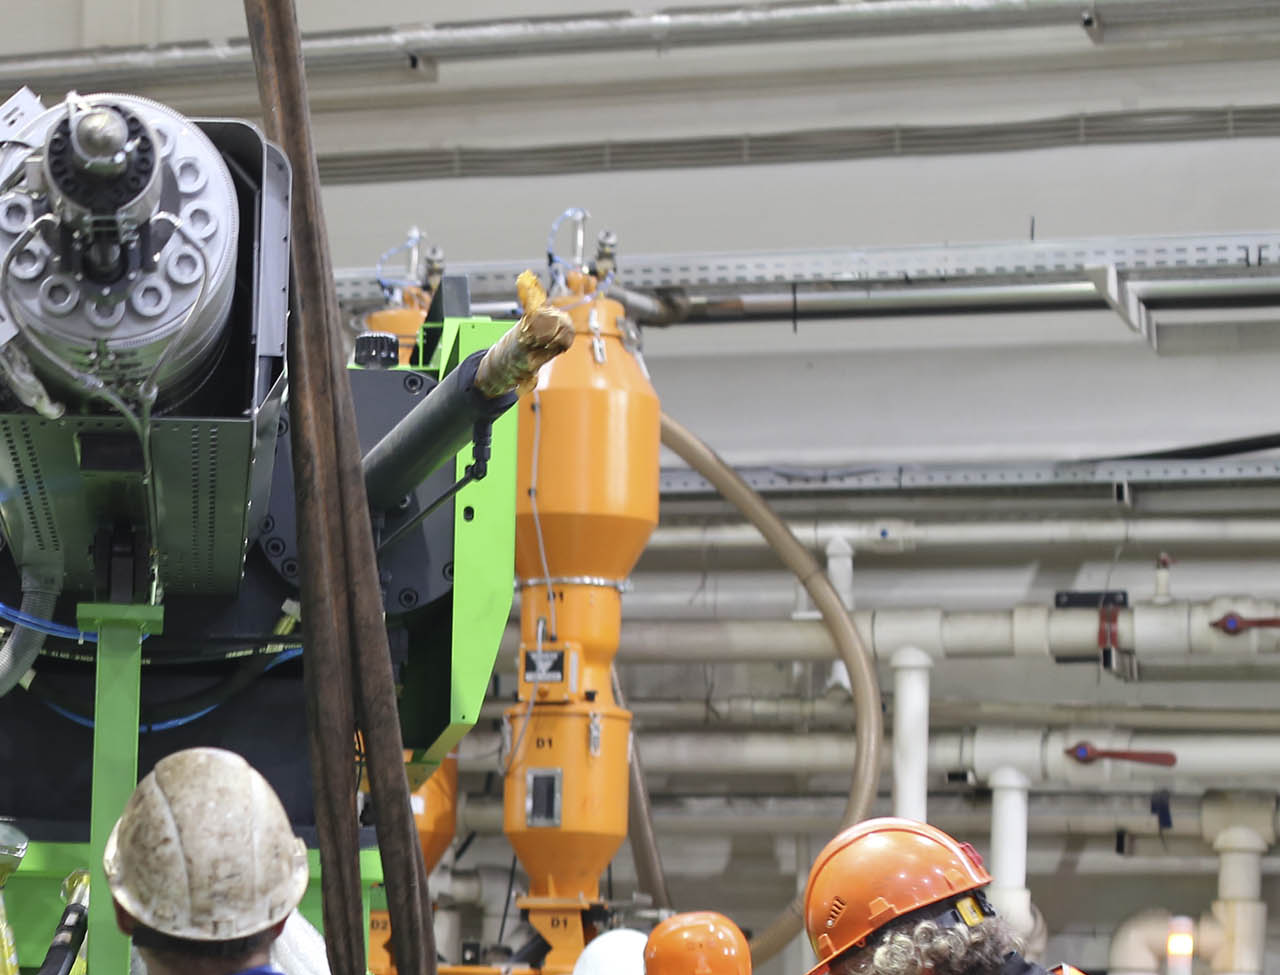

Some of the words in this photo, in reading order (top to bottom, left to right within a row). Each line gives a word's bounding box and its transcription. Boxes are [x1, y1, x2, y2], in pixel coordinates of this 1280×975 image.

[536, 738, 553, 748] D1
[371, 920, 388, 931] D2
[551, 917, 568, 929] D1
